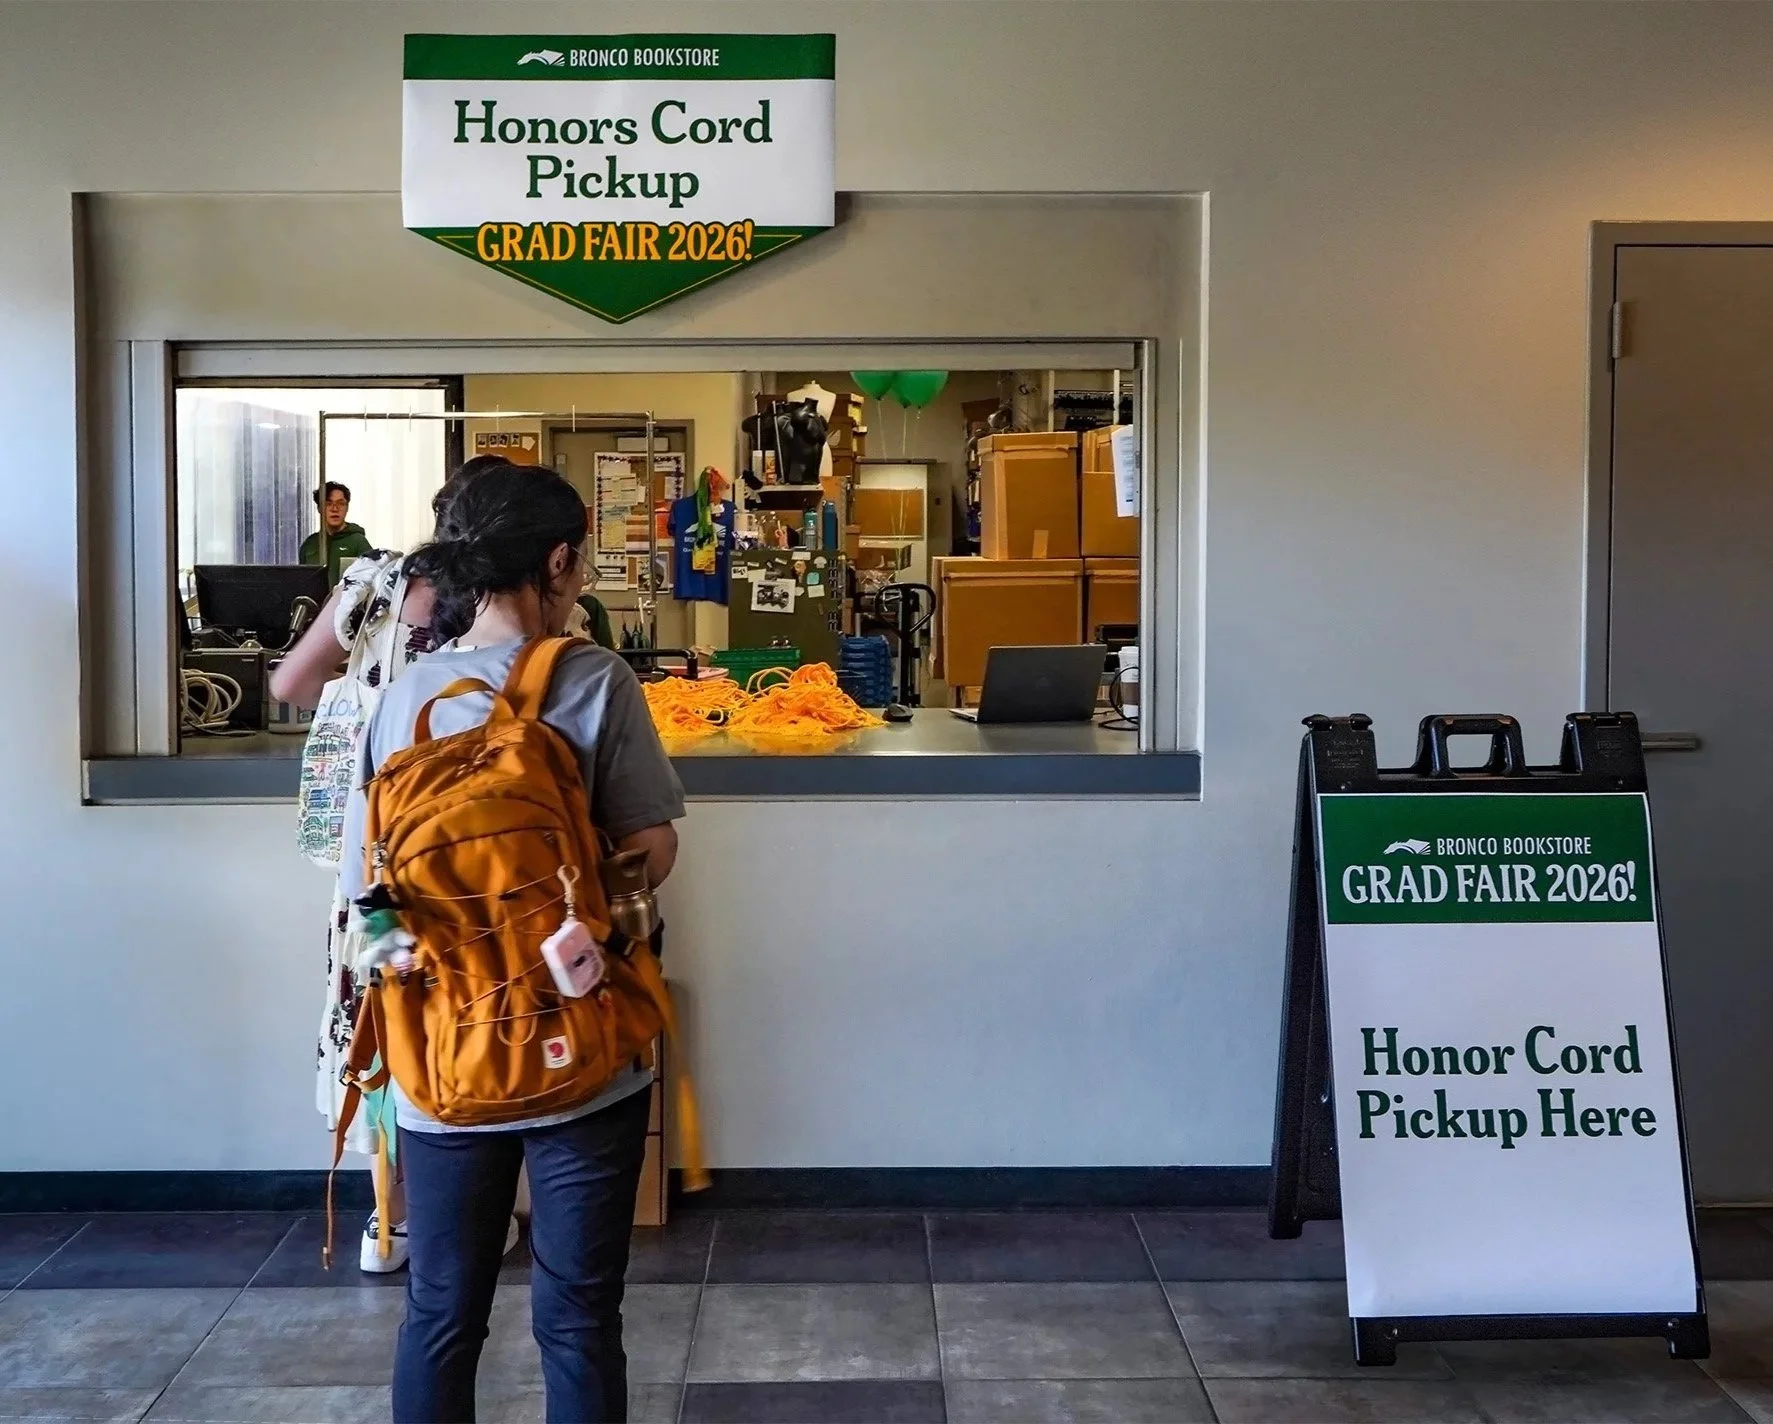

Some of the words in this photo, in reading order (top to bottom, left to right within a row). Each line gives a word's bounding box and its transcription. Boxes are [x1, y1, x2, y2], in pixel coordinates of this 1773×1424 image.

[570, 49, 629, 67] BRONCO
[634, 48, 720, 66] BOOKSTORE
[453, 99, 638, 145] Honors
[651, 99, 773, 145] Cord
[525, 154, 700, 208] Pickup
[476, 222, 577, 262] GRAD
[583, 223, 663, 261] FAIR
[668, 220, 754, 261] 2026!
[1437, 837, 1497, 855] BRONCO
[1503, 836, 1592, 855] BOOKSTORE
[1342, 865, 1448, 904] GRAD
[1455, 864, 1540, 903] FAIR
[1547, 861, 1637, 902] 2026!
[1360, 1027, 1515, 1076] Honor
[1524, 1025, 1644, 1075] Cord
[1356, 1089, 1528, 1149] Pickup
[1537, 1088, 1657, 1137] Here
